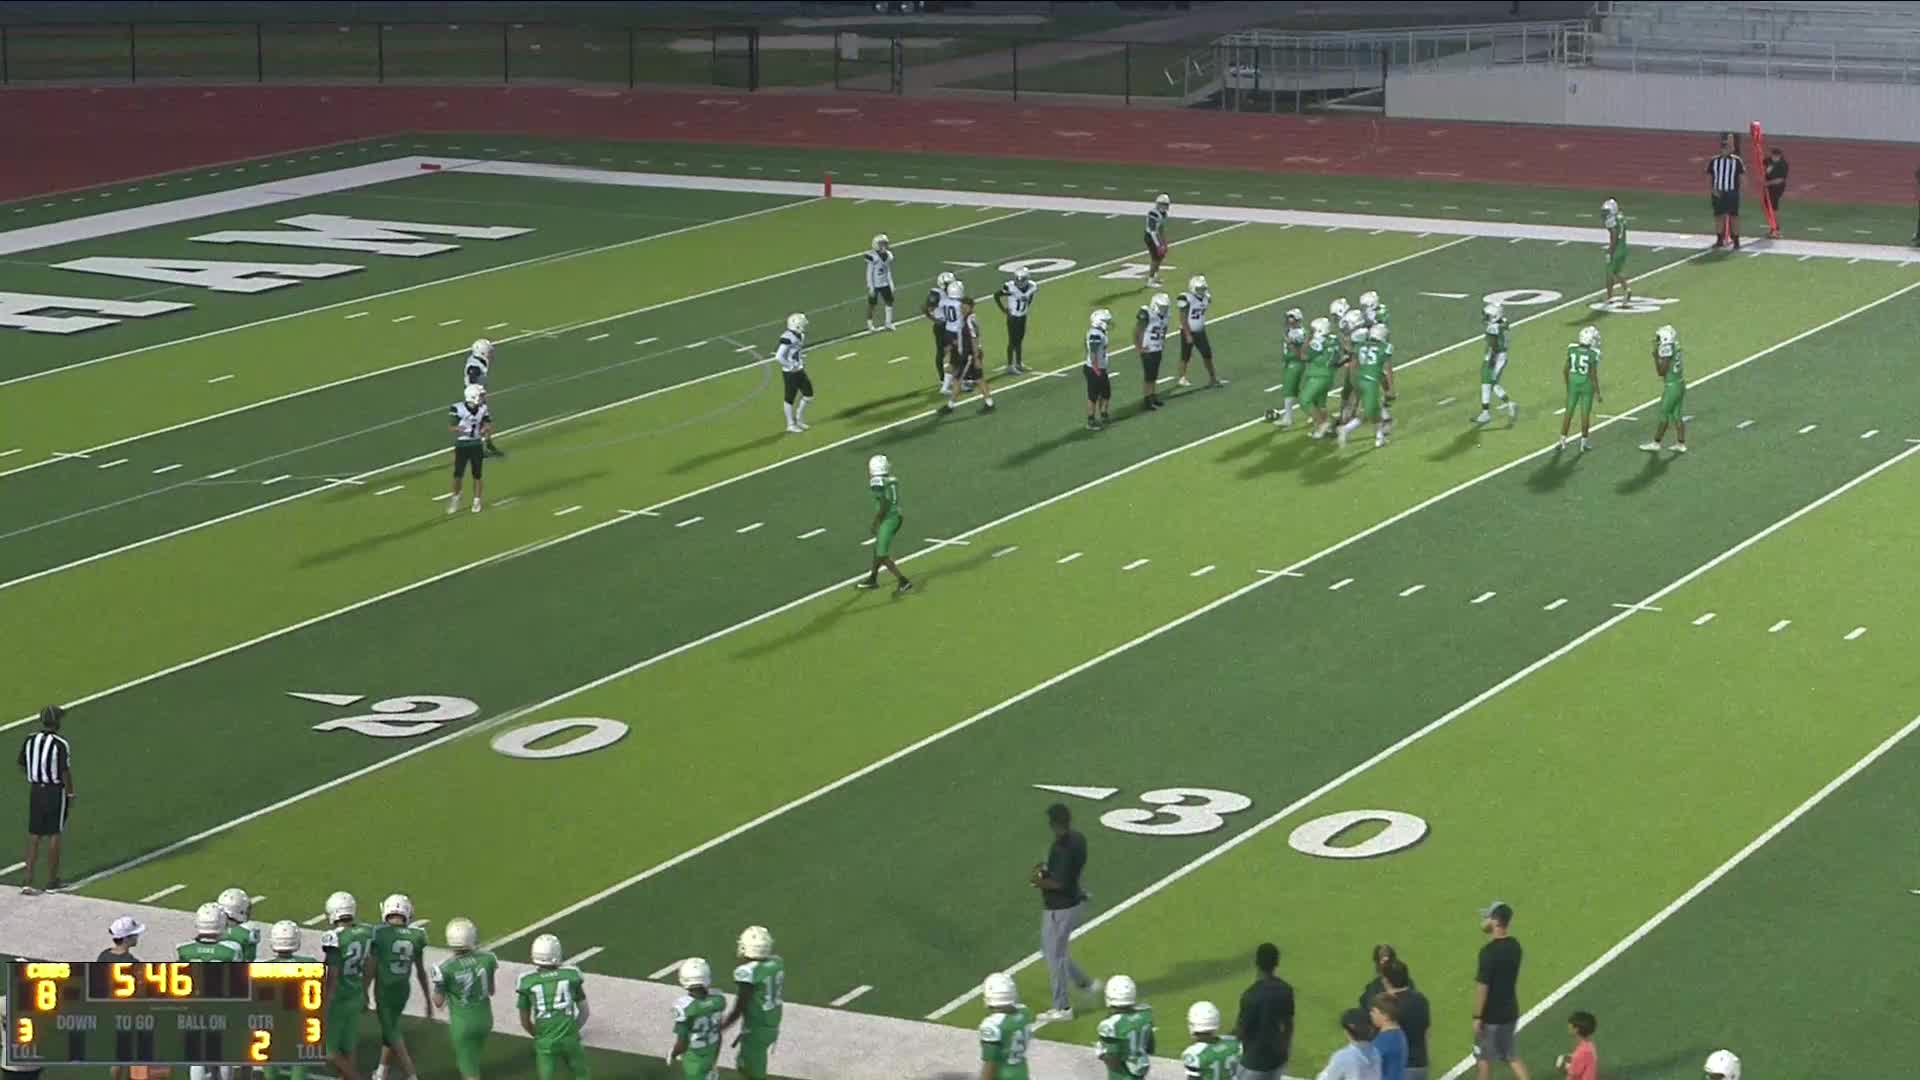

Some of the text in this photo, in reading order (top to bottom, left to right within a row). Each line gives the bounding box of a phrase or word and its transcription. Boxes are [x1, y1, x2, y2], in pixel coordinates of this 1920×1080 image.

[943, 305, 957, 323] 10
[1570, 353, 1588, 375] 15
[1100, 787, 1428, 858] 30
[390, 940, 414, 975] 3
[454, 967, 488, 1007] 71
[531, 980, 573, 1018] 14
